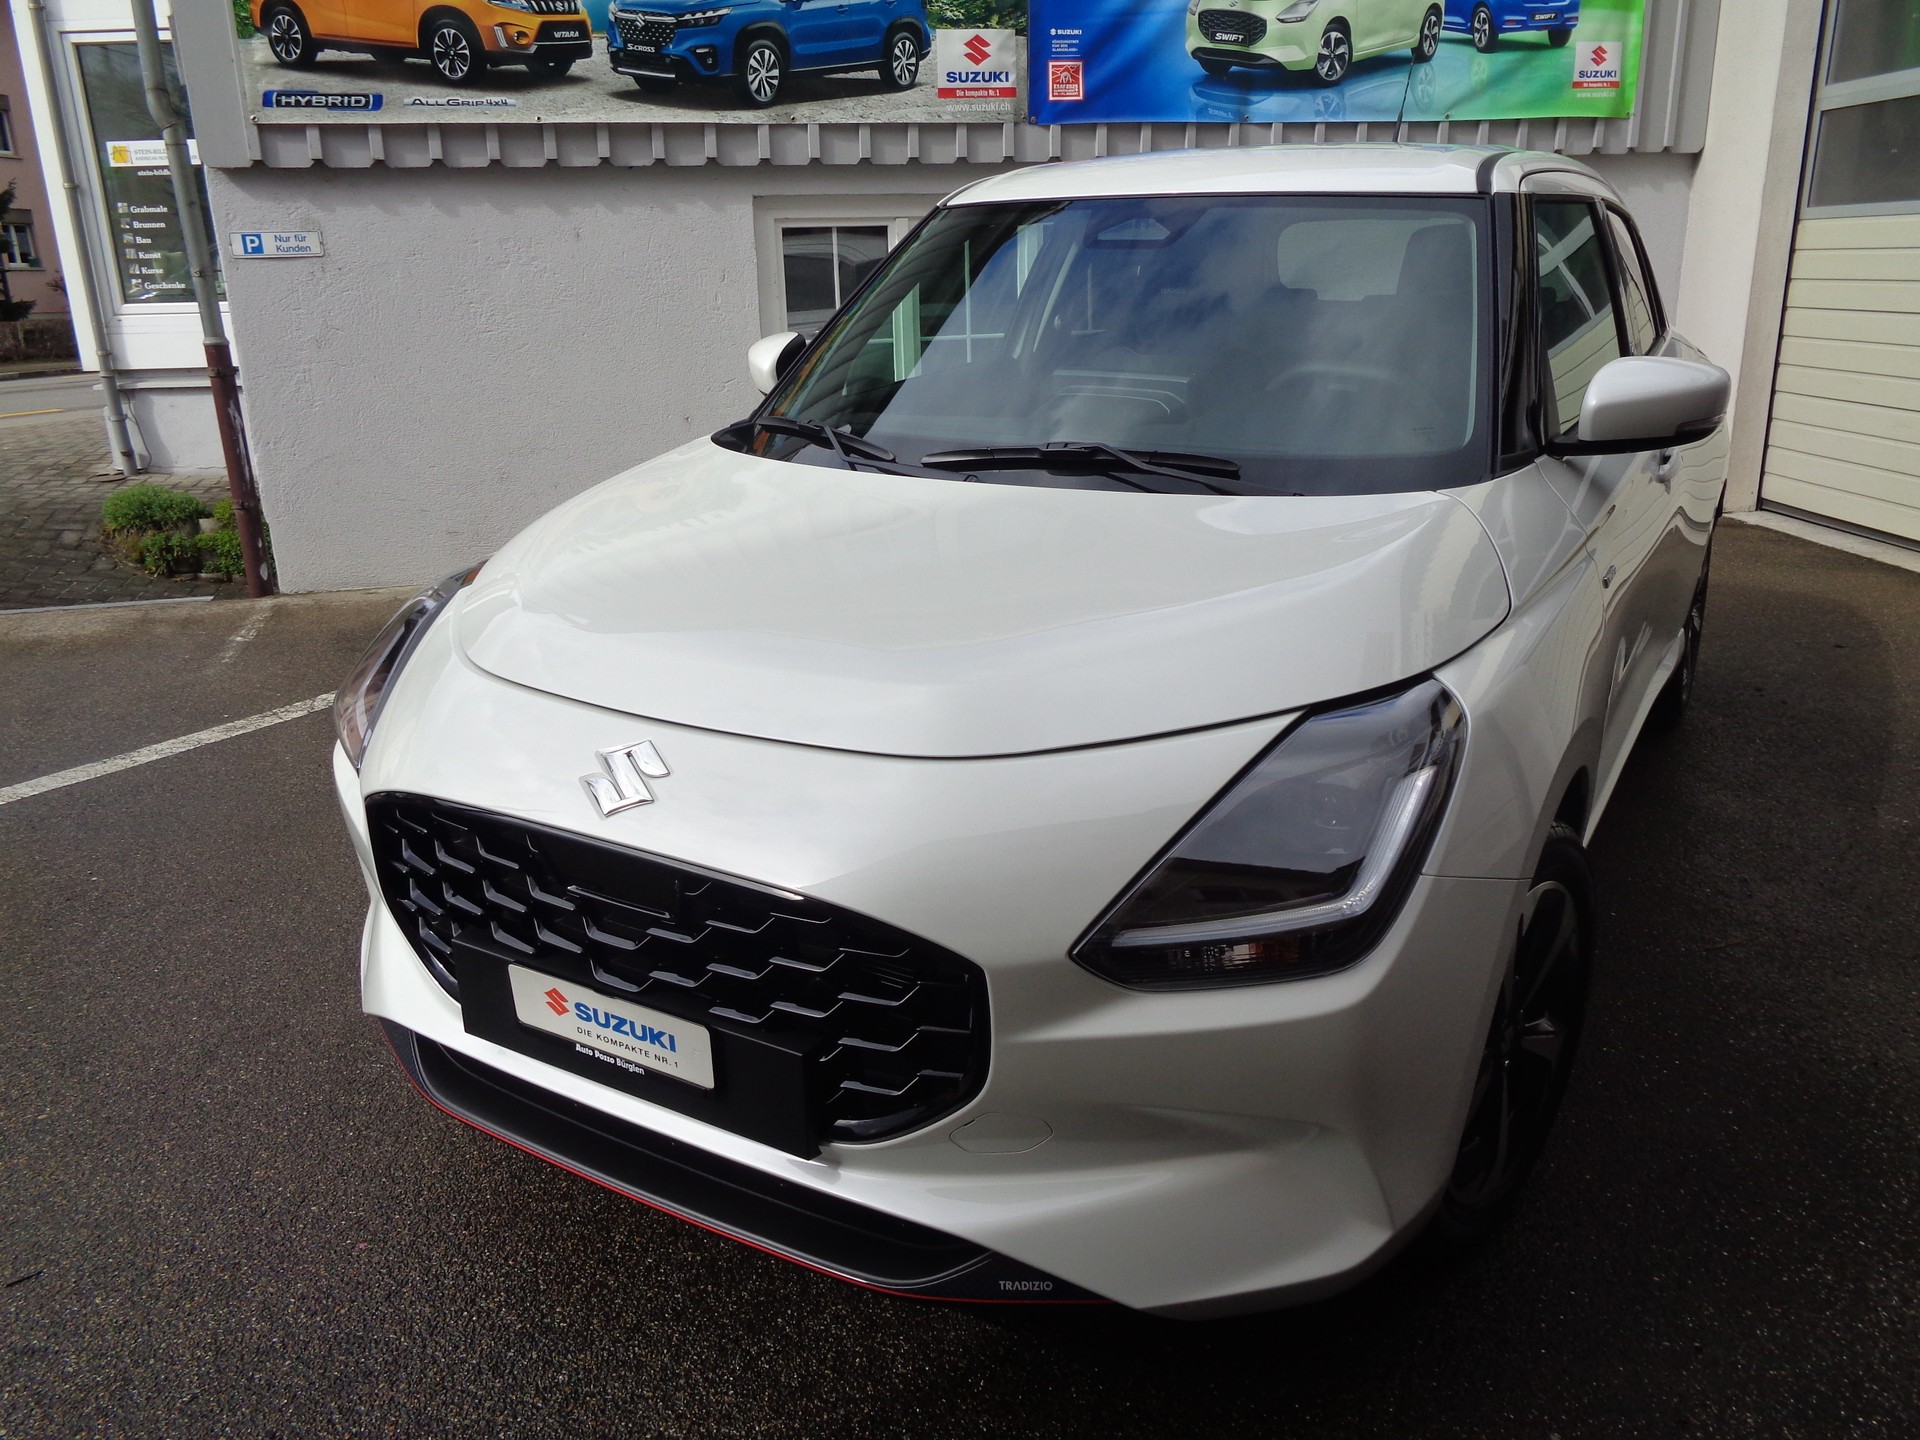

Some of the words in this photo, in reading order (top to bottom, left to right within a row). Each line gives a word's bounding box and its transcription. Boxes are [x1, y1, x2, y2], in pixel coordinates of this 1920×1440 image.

[1534, 13, 1556, 21] SWIFT
[1214, 32, 1245, 42] SWIFT
[946, 71, 1009, 83] SUZUKI
[1578, 70, 1617, 79] SUZUKI
[956, 89, 965, 97] Die
[965, 89, 988, 98] kompakte
[281, 95, 366, 107] HYBRID
[946, 102, 1011, 112] www.suzuki.ch
[130, 205, 168, 213] Grabmale
[133, 221, 166, 229] Brunnen
[136, 236, 152, 244] Bau
[274, 234, 291, 243] Nur
[294, 233, 307, 242] für
[245, 236, 260, 253] P
[276, 244, 311, 253] Kunden
[138, 251, 162, 260] Kunst
[141, 267, 164, 275] Kurse
[144, 281, 186, 290] Geschenke
[574, 1002, 677, 1053] SUZUKI
[576, 1026, 593, 1038] DIE
[596, 1033, 651, 1058] KOMPAKTE
[654, 1053, 671, 1066] NR.
[575, 1043, 593, 1056] Auto
[616, 1057, 645, 1075] Bürglen
[998, 1280, 1054, 1291] TRADIZIO
